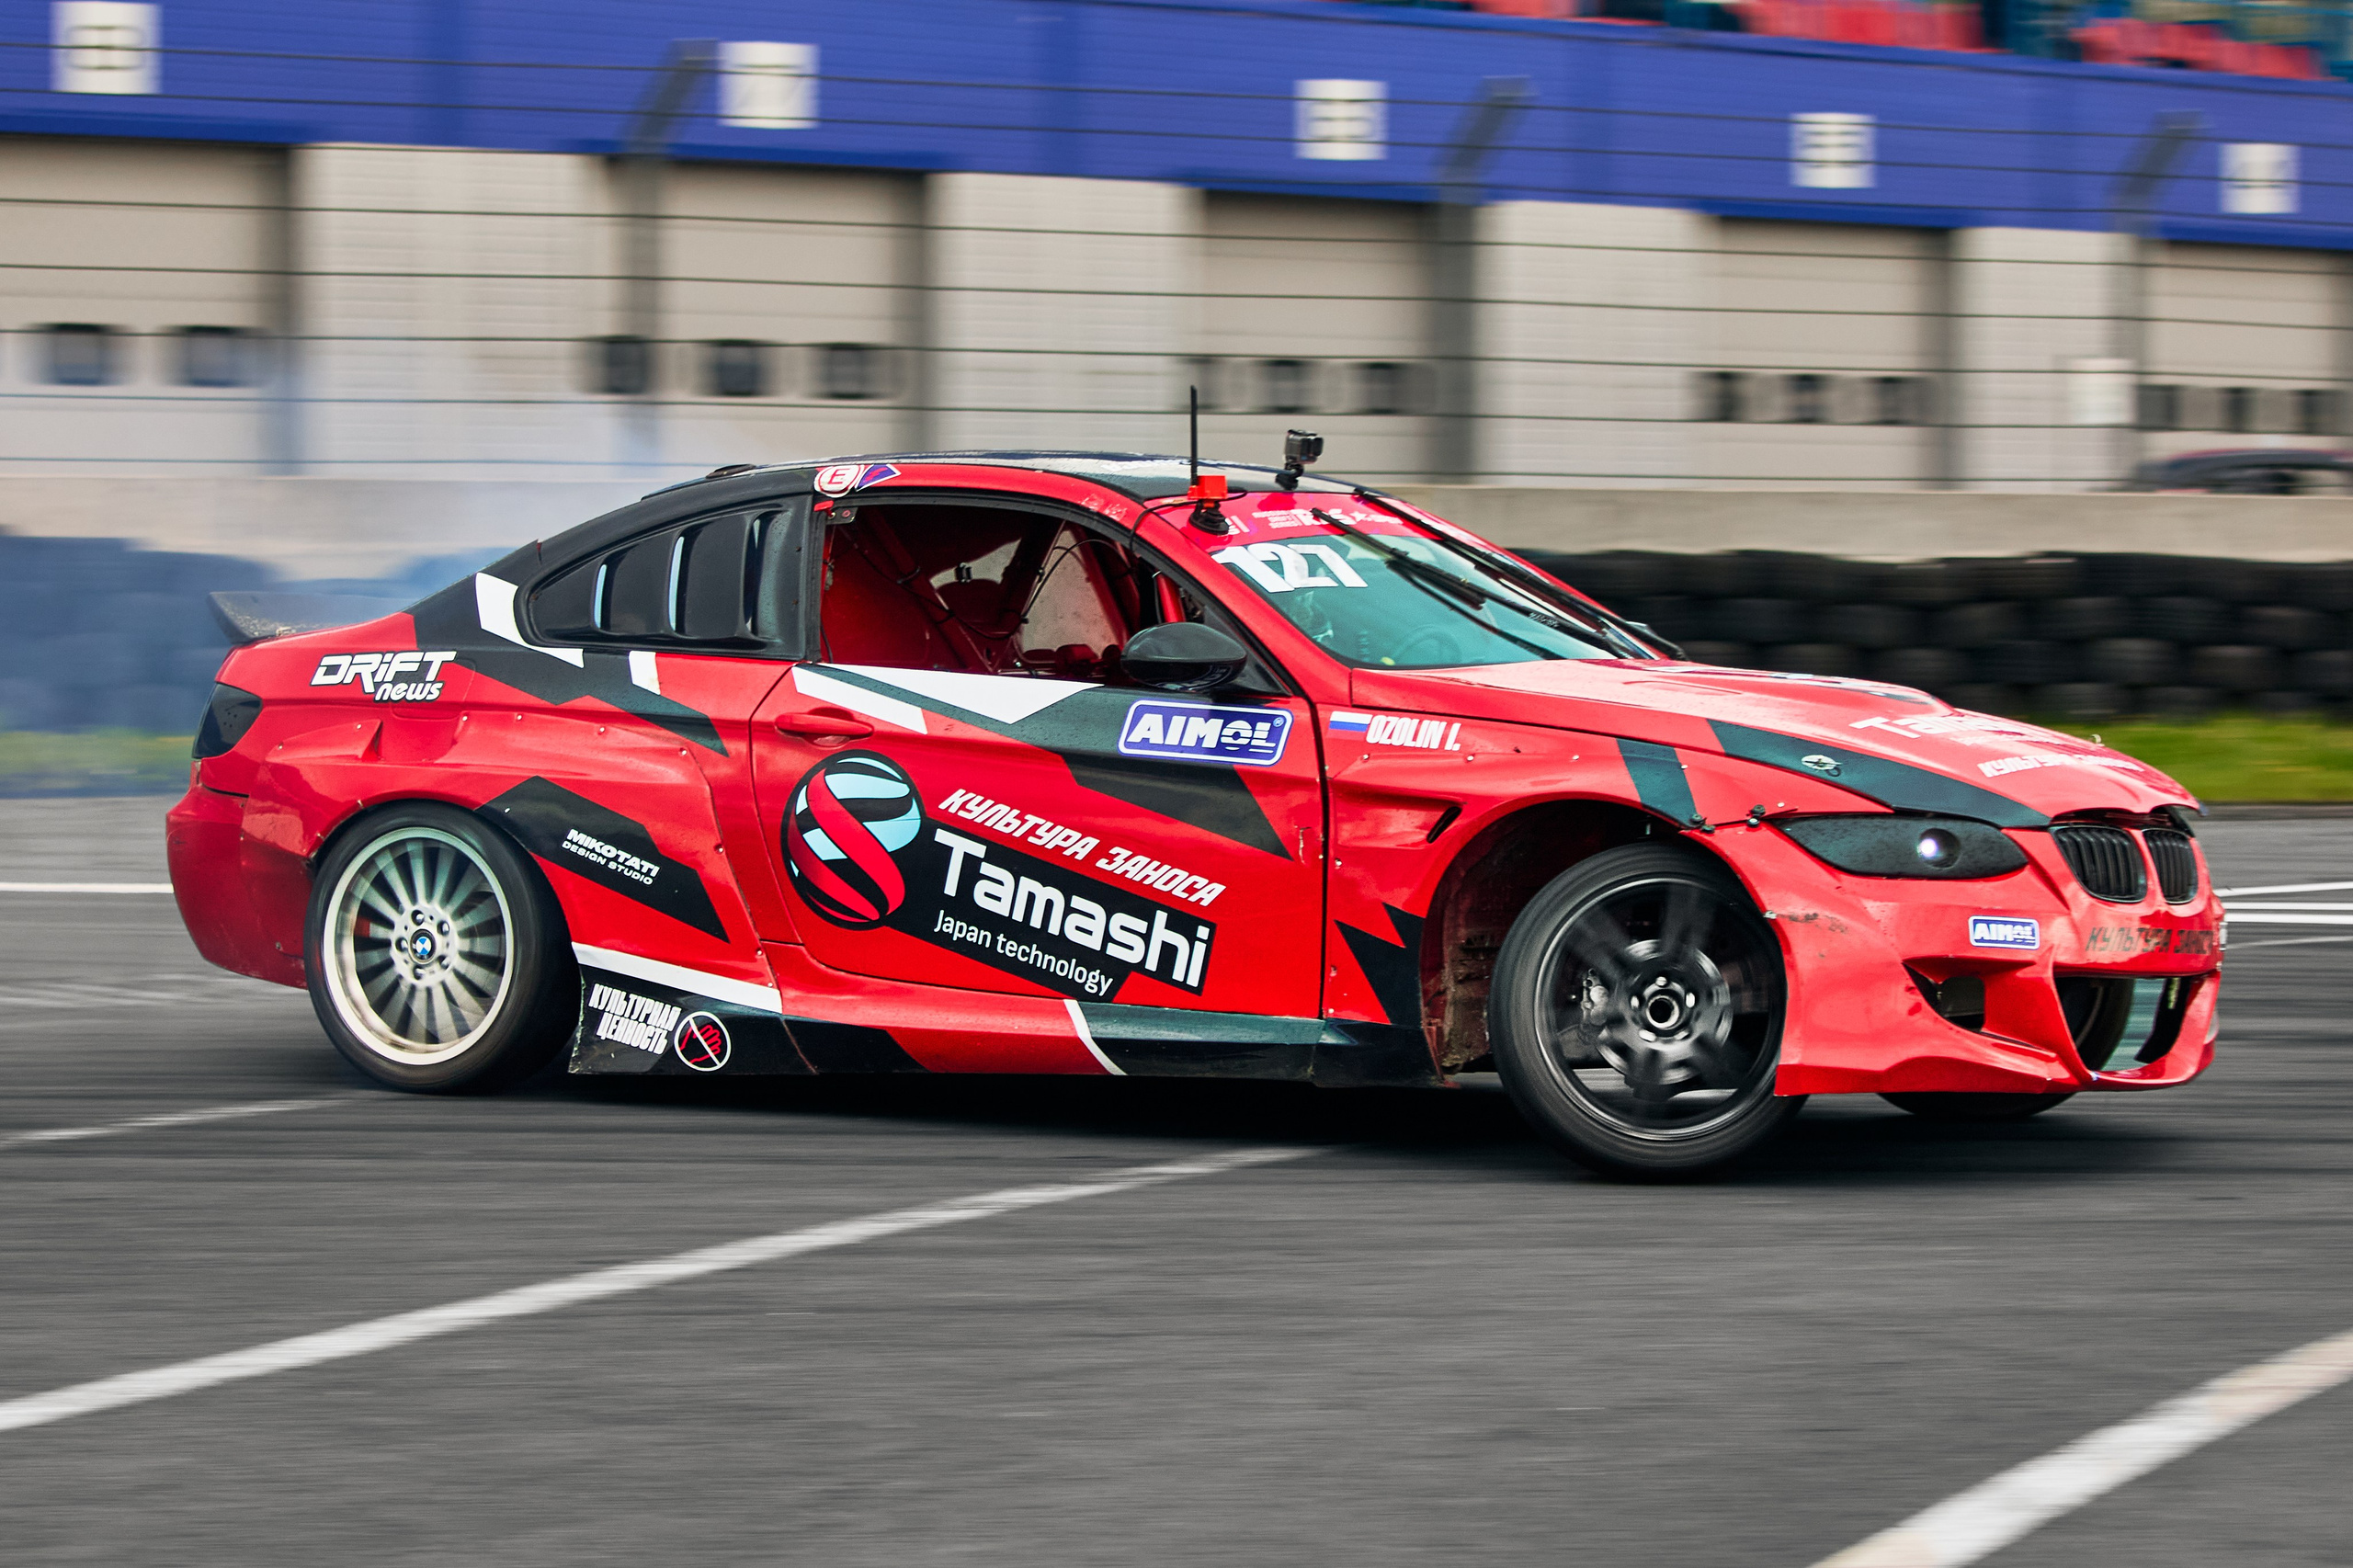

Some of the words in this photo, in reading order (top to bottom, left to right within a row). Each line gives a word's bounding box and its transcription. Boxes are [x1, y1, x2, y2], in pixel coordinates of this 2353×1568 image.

[1211, 543, 1368, 593] 127
[375, 683, 443, 701] news
[1127, 713, 1276, 754] AIMOL
[1366, 715, 1447, 749] OZOLIN
[1444, 722, 1461, 752] I.
[562, 840, 607, 866] DESIGN
[608, 861, 654, 885] STUDIO
[566, 829, 660, 877] MIKOTATI
[938, 789, 1099, 860] КУЛЬТУРА
[1096, 846, 1226, 906] ЗАНОСА
[934, 828, 1210, 987] Tamashi
[934, 909, 992, 948] Japan
[996, 933, 1113, 996] technology
[588, 983, 682, 1031] КУЛЬТУРНАЯ
[597, 1012, 668, 1055] ЦЕННОСТЬ
